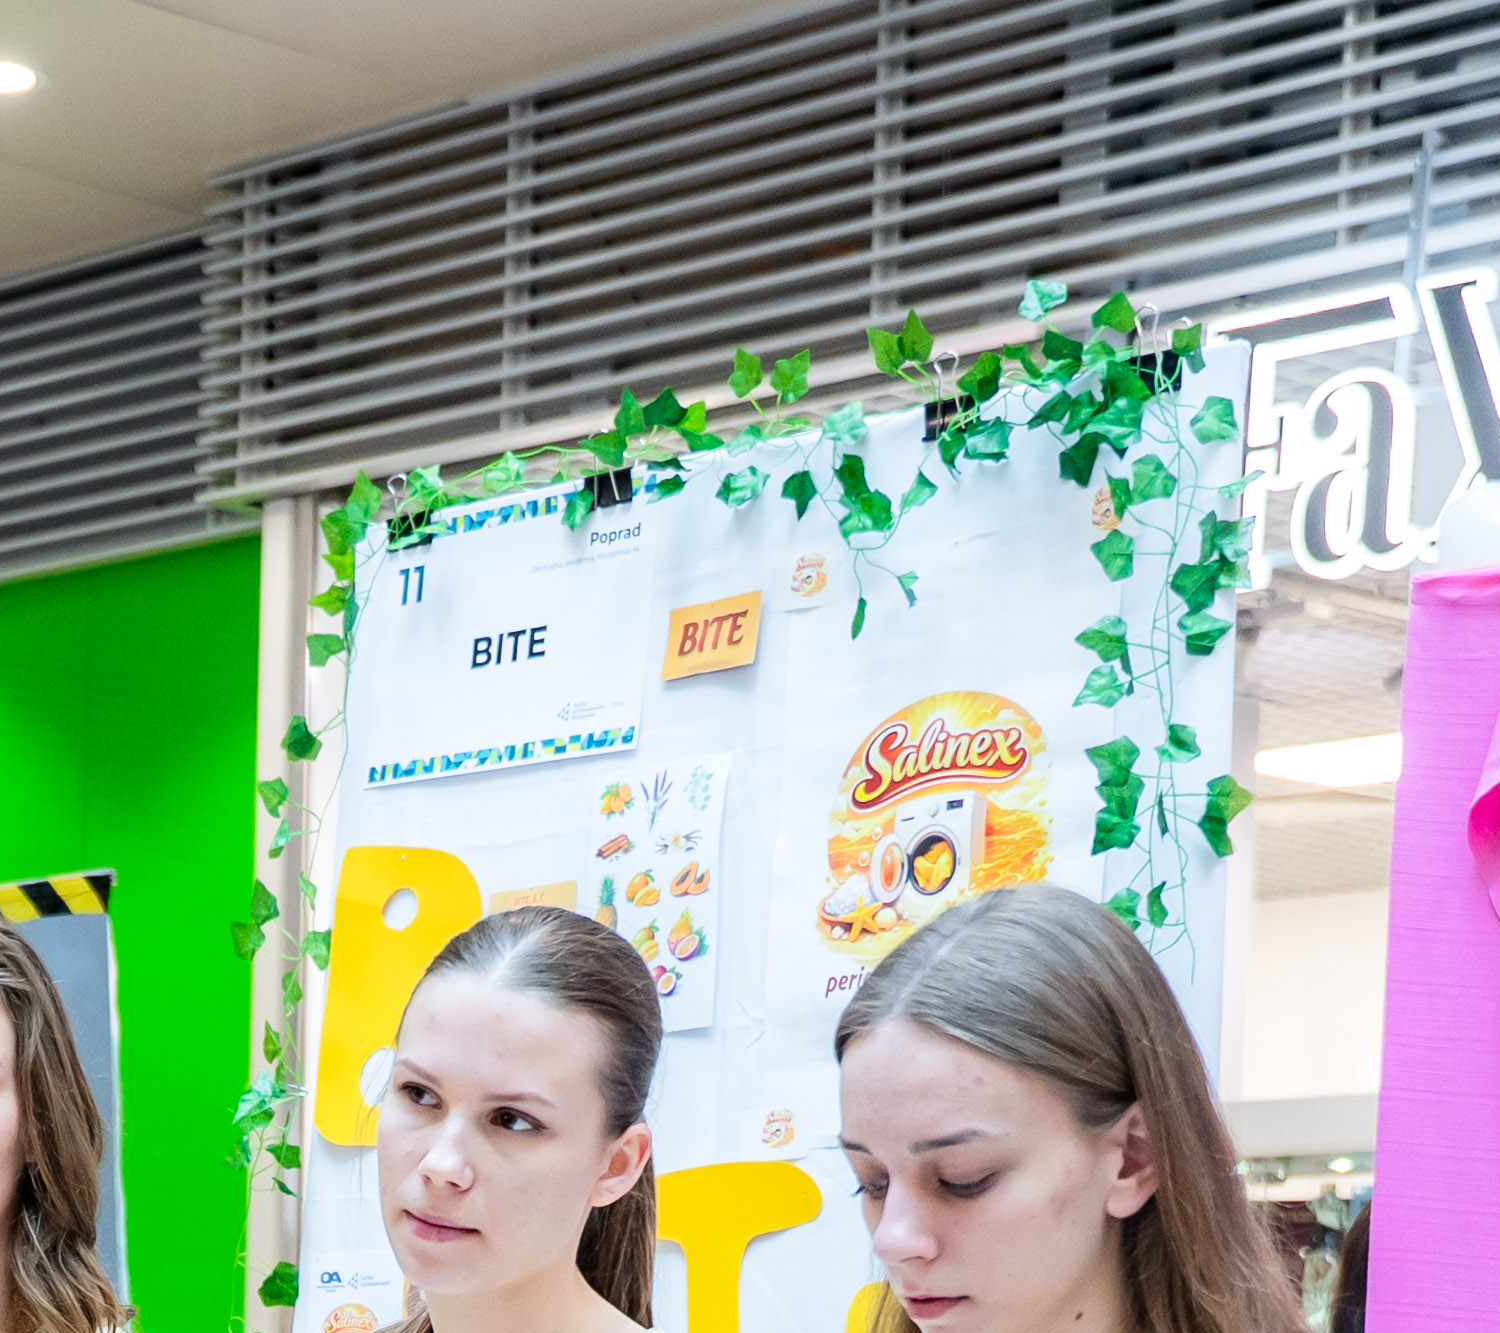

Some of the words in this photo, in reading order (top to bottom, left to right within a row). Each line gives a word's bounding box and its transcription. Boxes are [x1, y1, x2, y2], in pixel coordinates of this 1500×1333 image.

[590, 522, 641, 546] Poprad
[399, 565, 425, 606] 11
[471, 625, 547, 669] BITE
[678, 608, 749, 657] BITE
[852, 718, 1029, 808] Salinex
